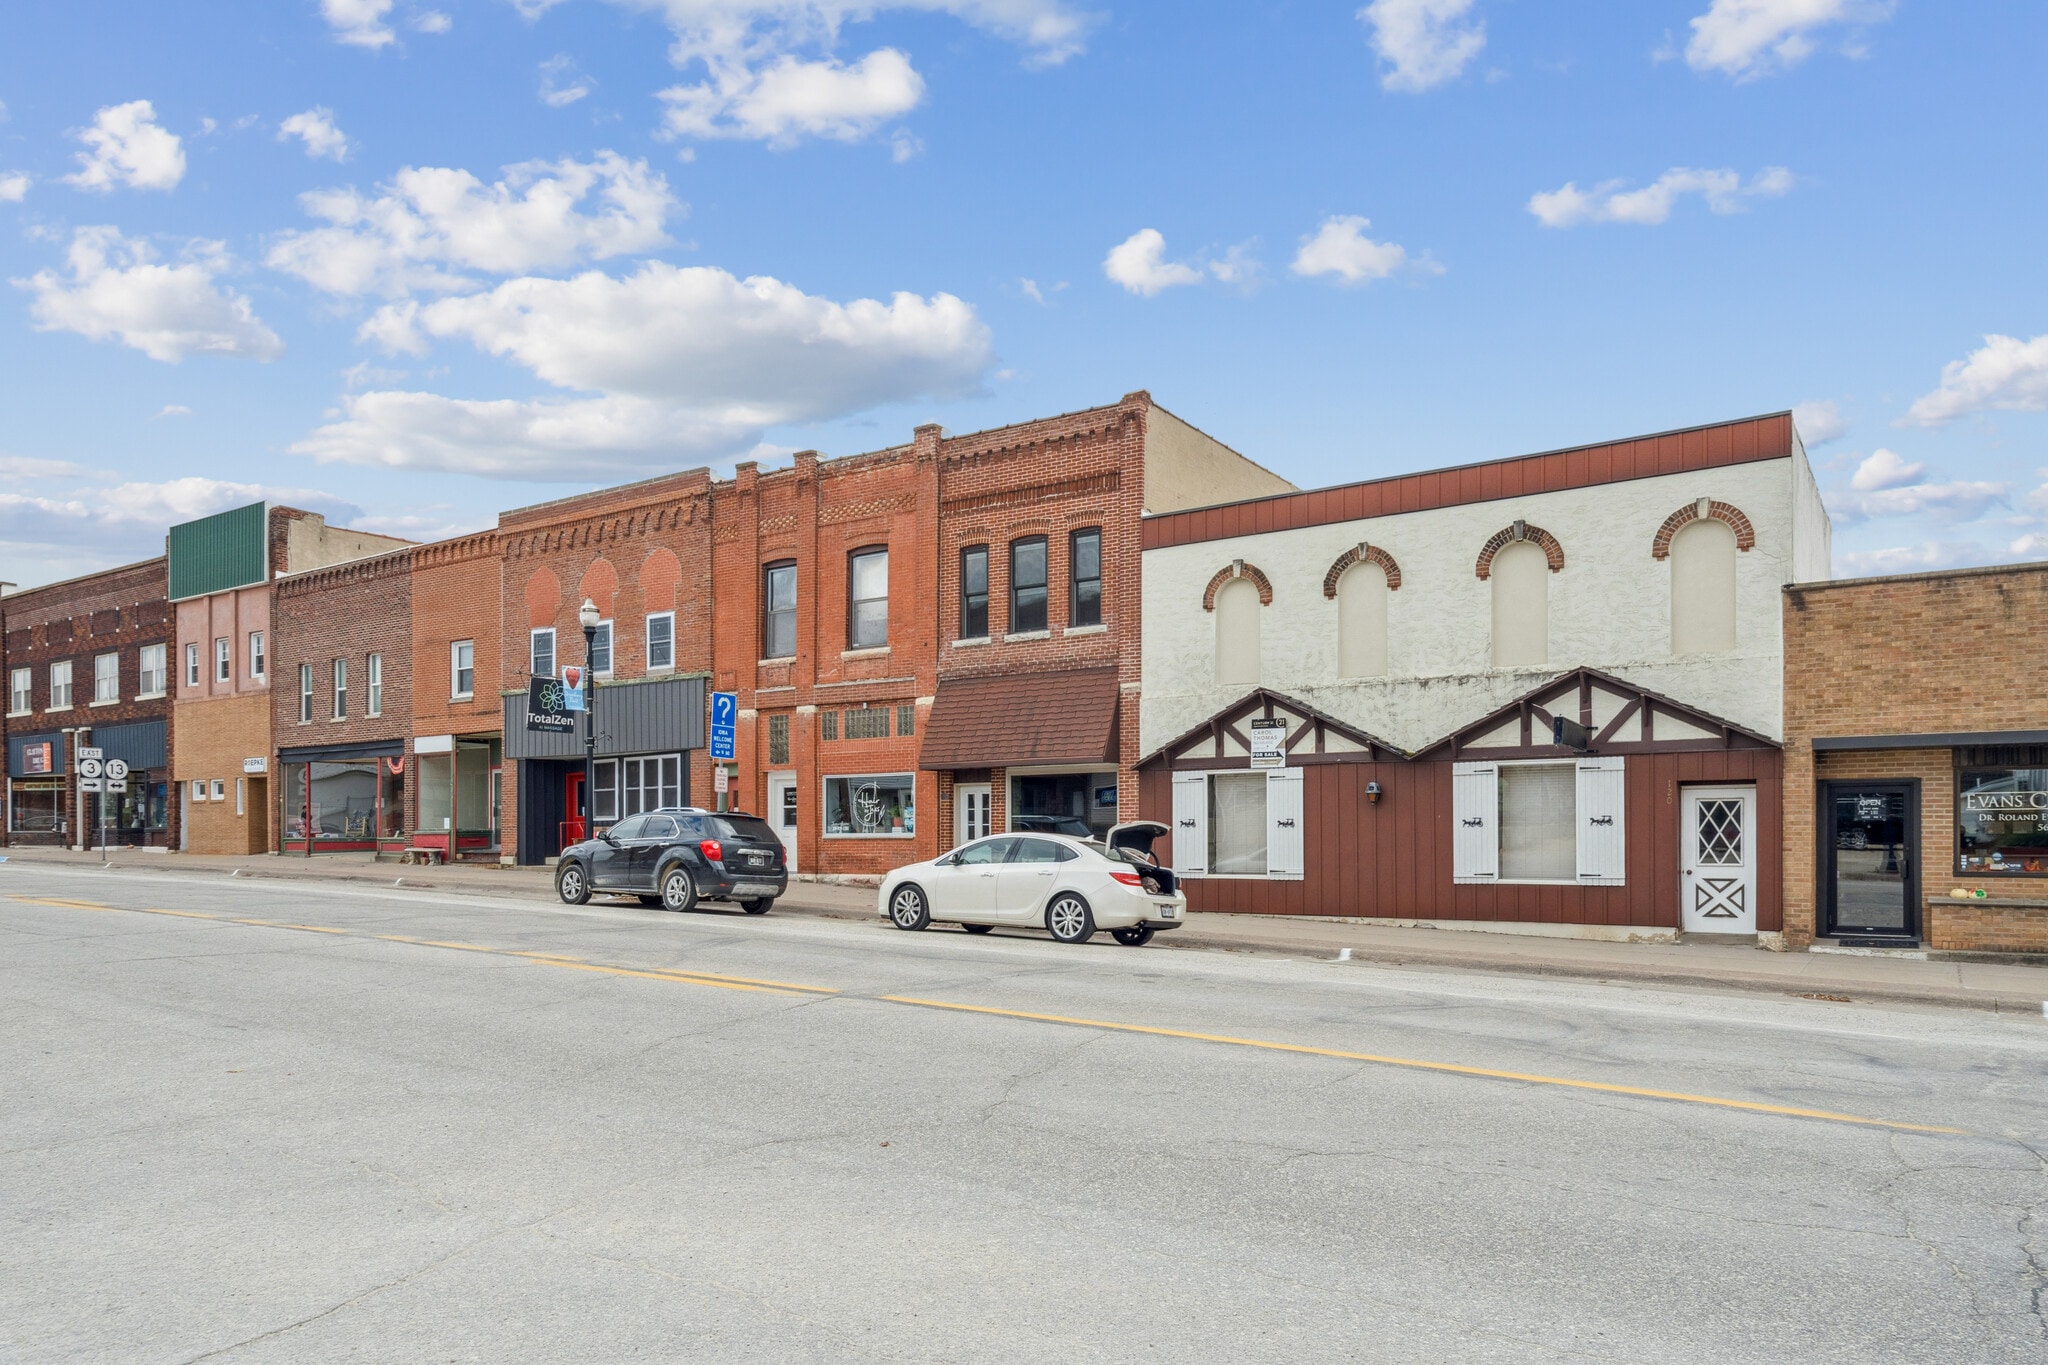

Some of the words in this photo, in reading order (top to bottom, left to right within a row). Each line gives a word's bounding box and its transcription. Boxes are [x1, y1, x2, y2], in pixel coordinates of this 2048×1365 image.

[528, 713, 574, 726] TotalZen
[87, 763, 96, 774] 3
[110, 764, 124, 775] 13
[1966, 793, 2023, 809] EVANS
[1998, 813, 2038, 821] ROLAND
